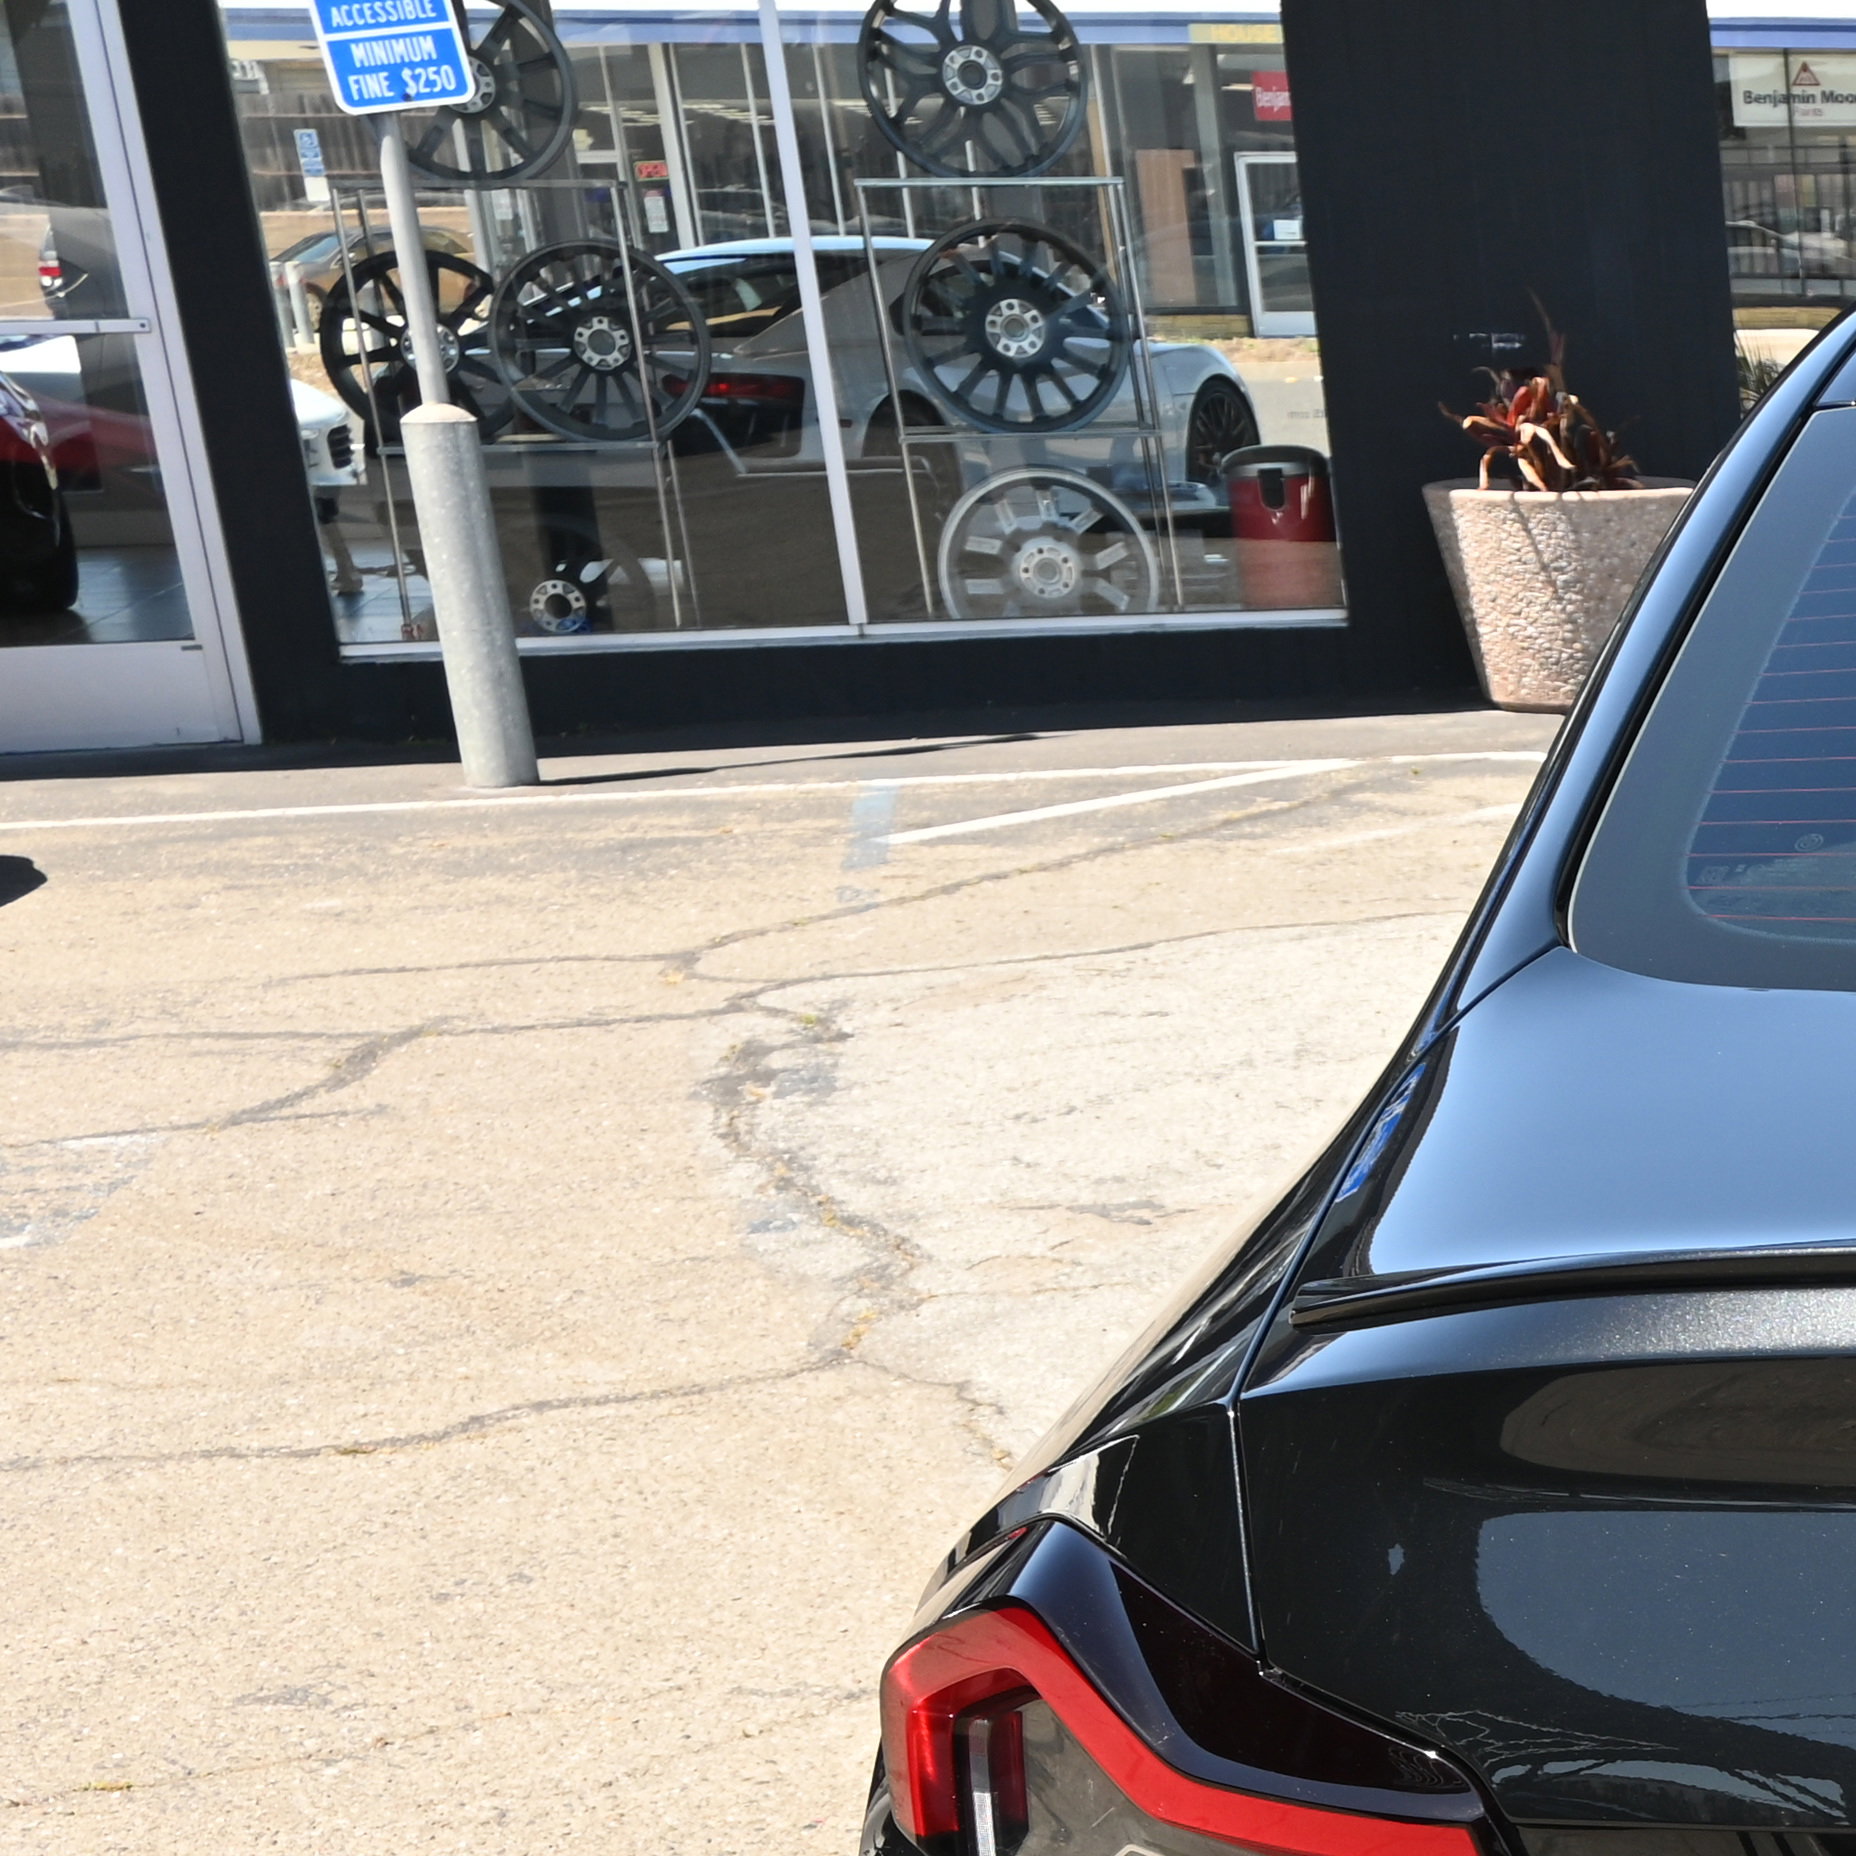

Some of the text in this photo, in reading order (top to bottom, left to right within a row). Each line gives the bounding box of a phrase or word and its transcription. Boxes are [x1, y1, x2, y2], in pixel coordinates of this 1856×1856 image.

[330, 0, 437, 28] ACCESSIBLE
[349, 35, 438, 68] MINIMUM
[348, 64, 457, 101] FINE $250
[1743, 89, 1816, 107] Benjamin
